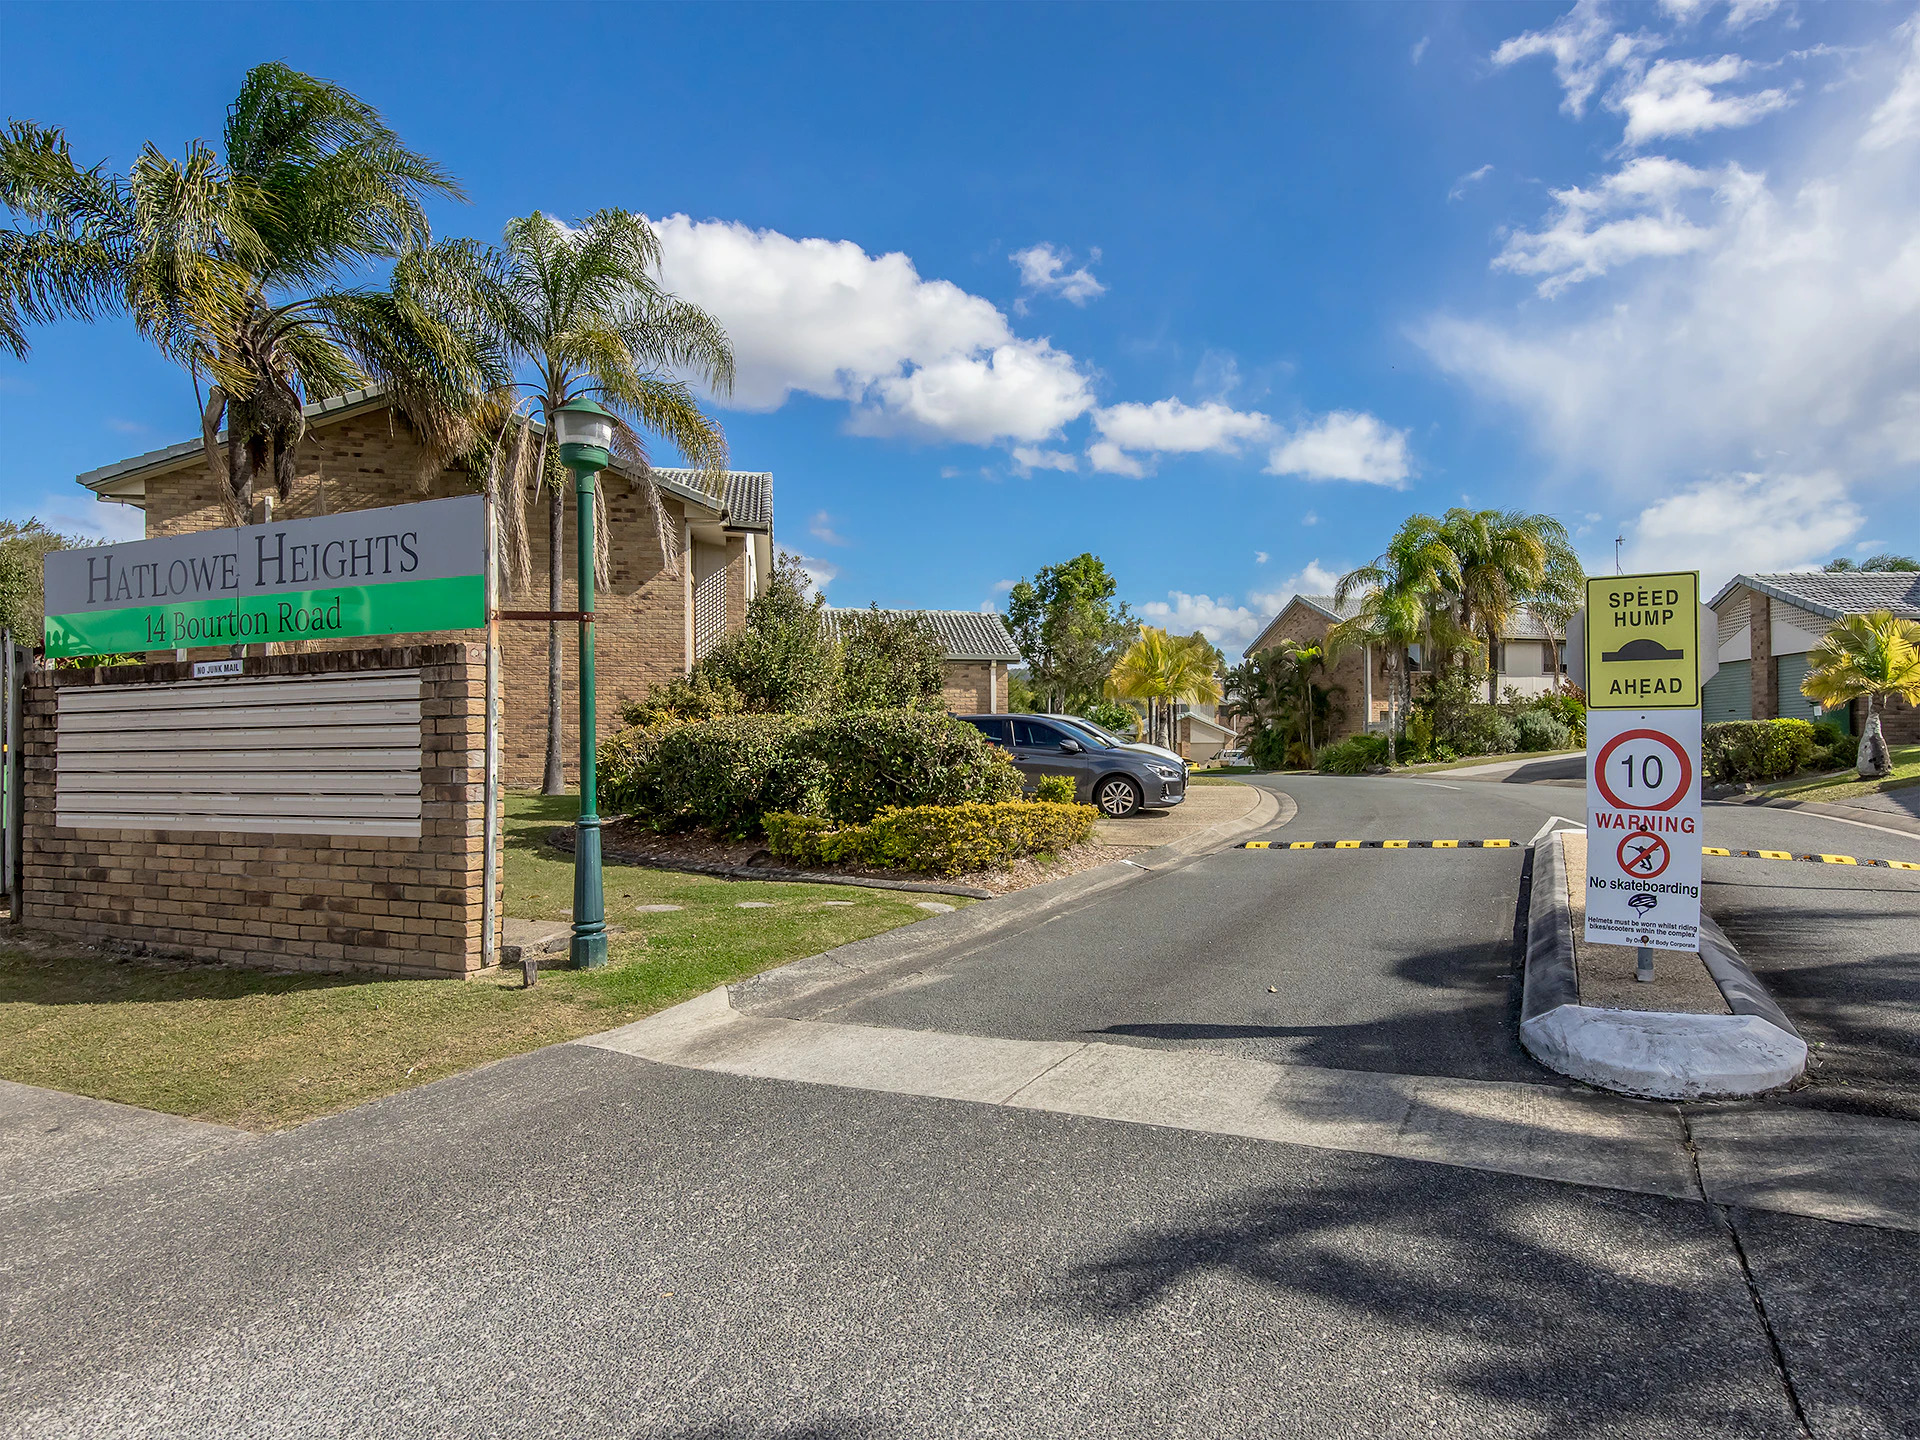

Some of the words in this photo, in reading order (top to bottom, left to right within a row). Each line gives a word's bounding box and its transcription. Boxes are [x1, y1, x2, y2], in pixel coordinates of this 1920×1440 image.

[87, 554, 239, 603] HATLOWE
[255, 532, 420, 586] HEIGHTS
[1608, 589, 1679, 609] SPEED
[145, 613, 166, 644] 14
[173, 605, 268, 643] Bourton
[277, 596, 342, 634] Road
[1614, 609, 1674, 627] HUMP
[197, 666, 205, 674] NO
[207, 665, 222, 674] JUNK
[225, 664, 239, 672] MAIL
[1609, 677, 1682, 695] AHEAD
[1621, 754, 1663, 789] 10
[1595, 812, 1695, 834] WARNING
[1589, 876, 1607, 889] No
[1609, 878, 1698, 898] skateboarding
[1587, 916, 1613, 924] Helmets
[1658, 922, 1677, 930] whilst
[1679, 925, 1698, 933] riding
[1589, 923, 1635, 932] bikes/scooters
